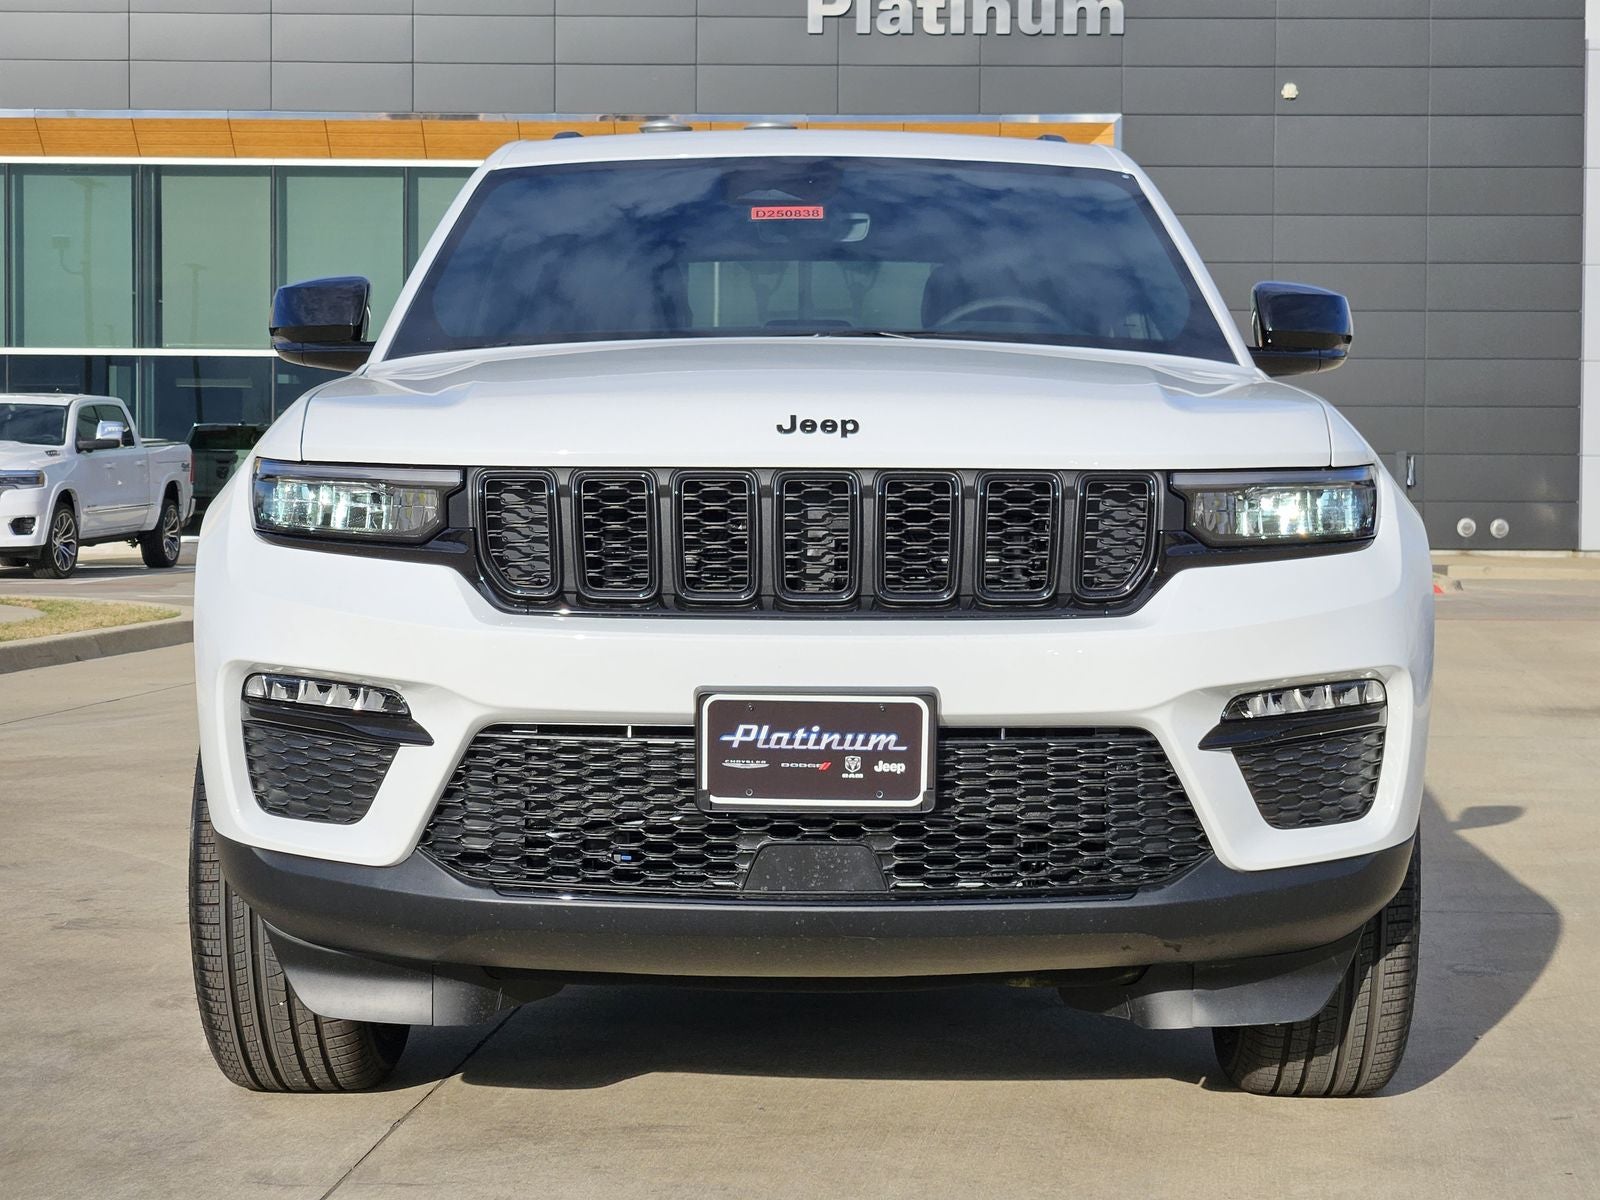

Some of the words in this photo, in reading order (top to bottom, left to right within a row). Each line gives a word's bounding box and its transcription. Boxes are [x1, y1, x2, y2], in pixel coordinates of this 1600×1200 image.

[807, 0, 1125, 36] Platinum
[755, 209, 820, 218] D250838
[776, 414, 860, 438] Jeep
[719, 724, 908, 751] Platinum
[873, 760, 906, 774] Jeep
